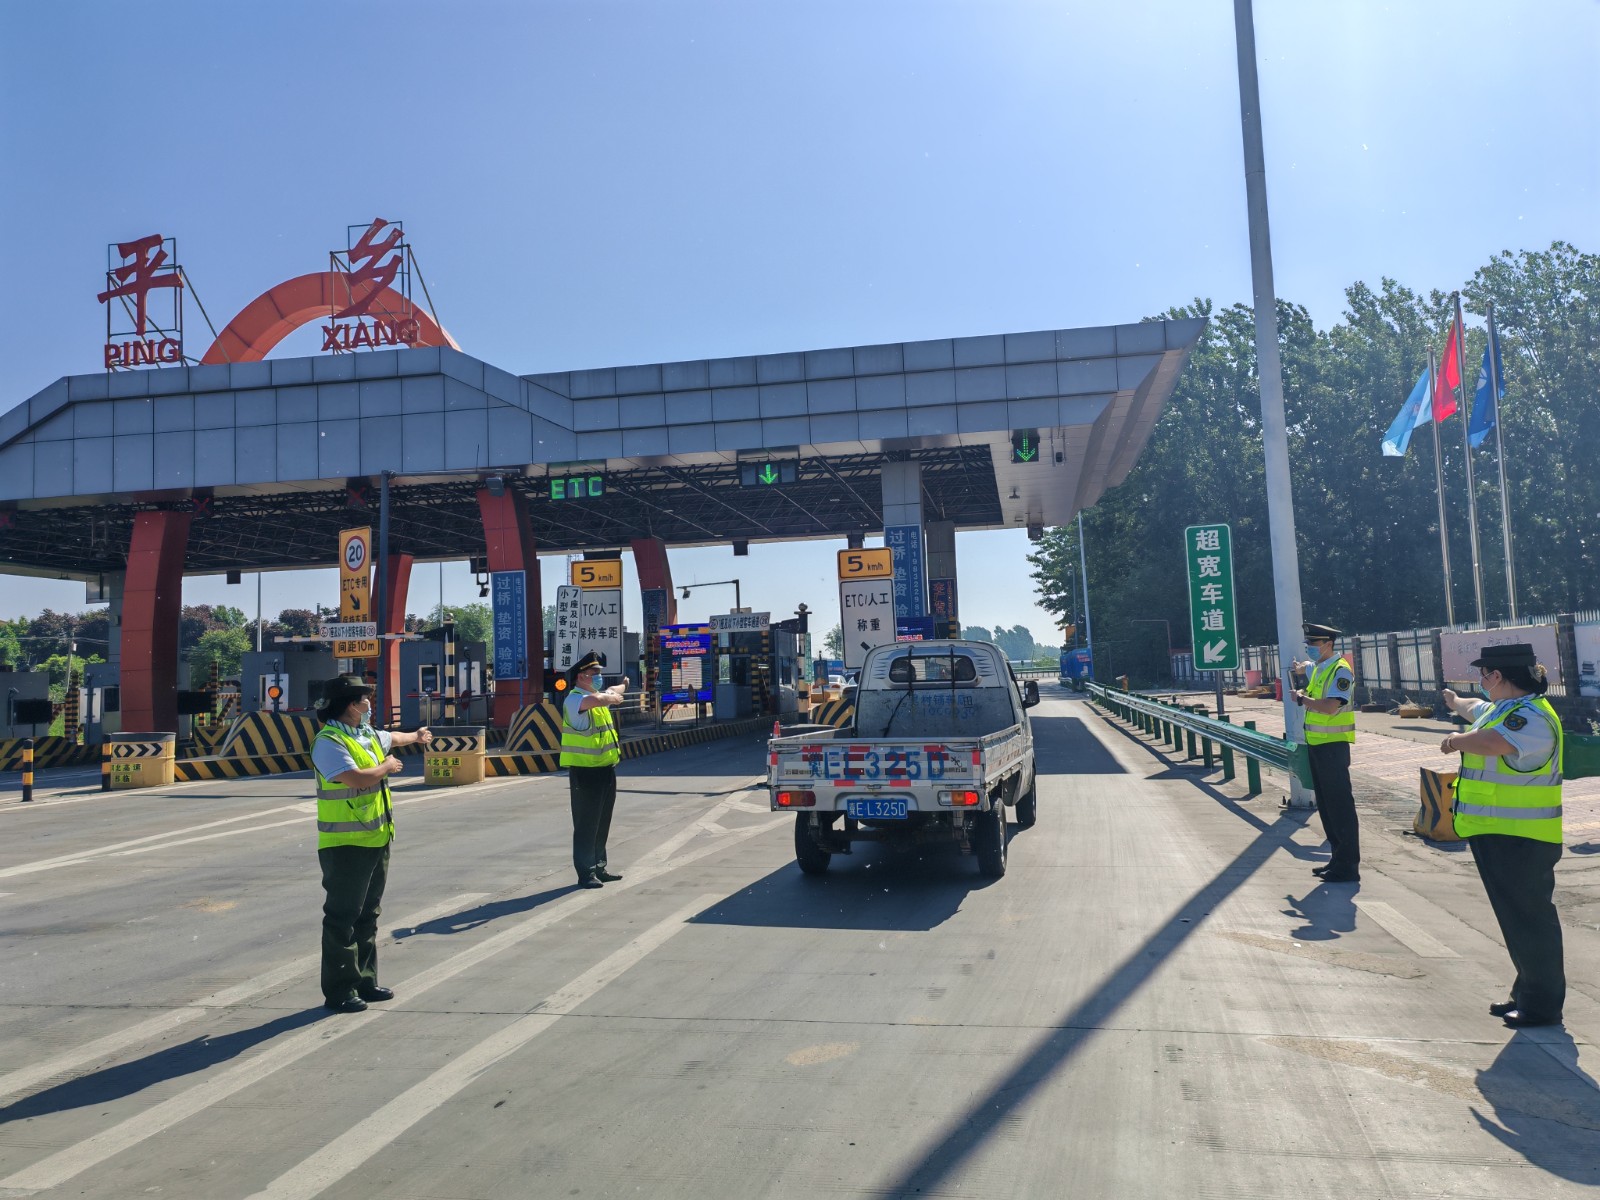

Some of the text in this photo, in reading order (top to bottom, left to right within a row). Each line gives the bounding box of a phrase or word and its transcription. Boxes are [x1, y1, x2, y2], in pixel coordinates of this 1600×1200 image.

[97, 217, 405, 336] 平 乡
[104, 319, 420, 368] PING XIANG
[551, 476, 603, 500] ETC
[348, 545, 363, 562] 20
[847, 555, 884, 572] 5 km/h
[342, 576, 368, 592] ETC专用
[581, 567, 614, 582] 5 km/h
[1195, 529, 1226, 632] 超宽车道
[581, 603, 617, 617] TC/人工
[845, 592, 889, 608] ETC/人工
[558, 589, 569, 640] 小型客车
[569, 589, 579, 640] 7座及以下
[497, 576, 513, 675] 过桥 垫资 验资
[857, 618, 880, 632] 称重
[338, 640, 375, 653] 间距10m
[561, 643, 572, 667] 通道
